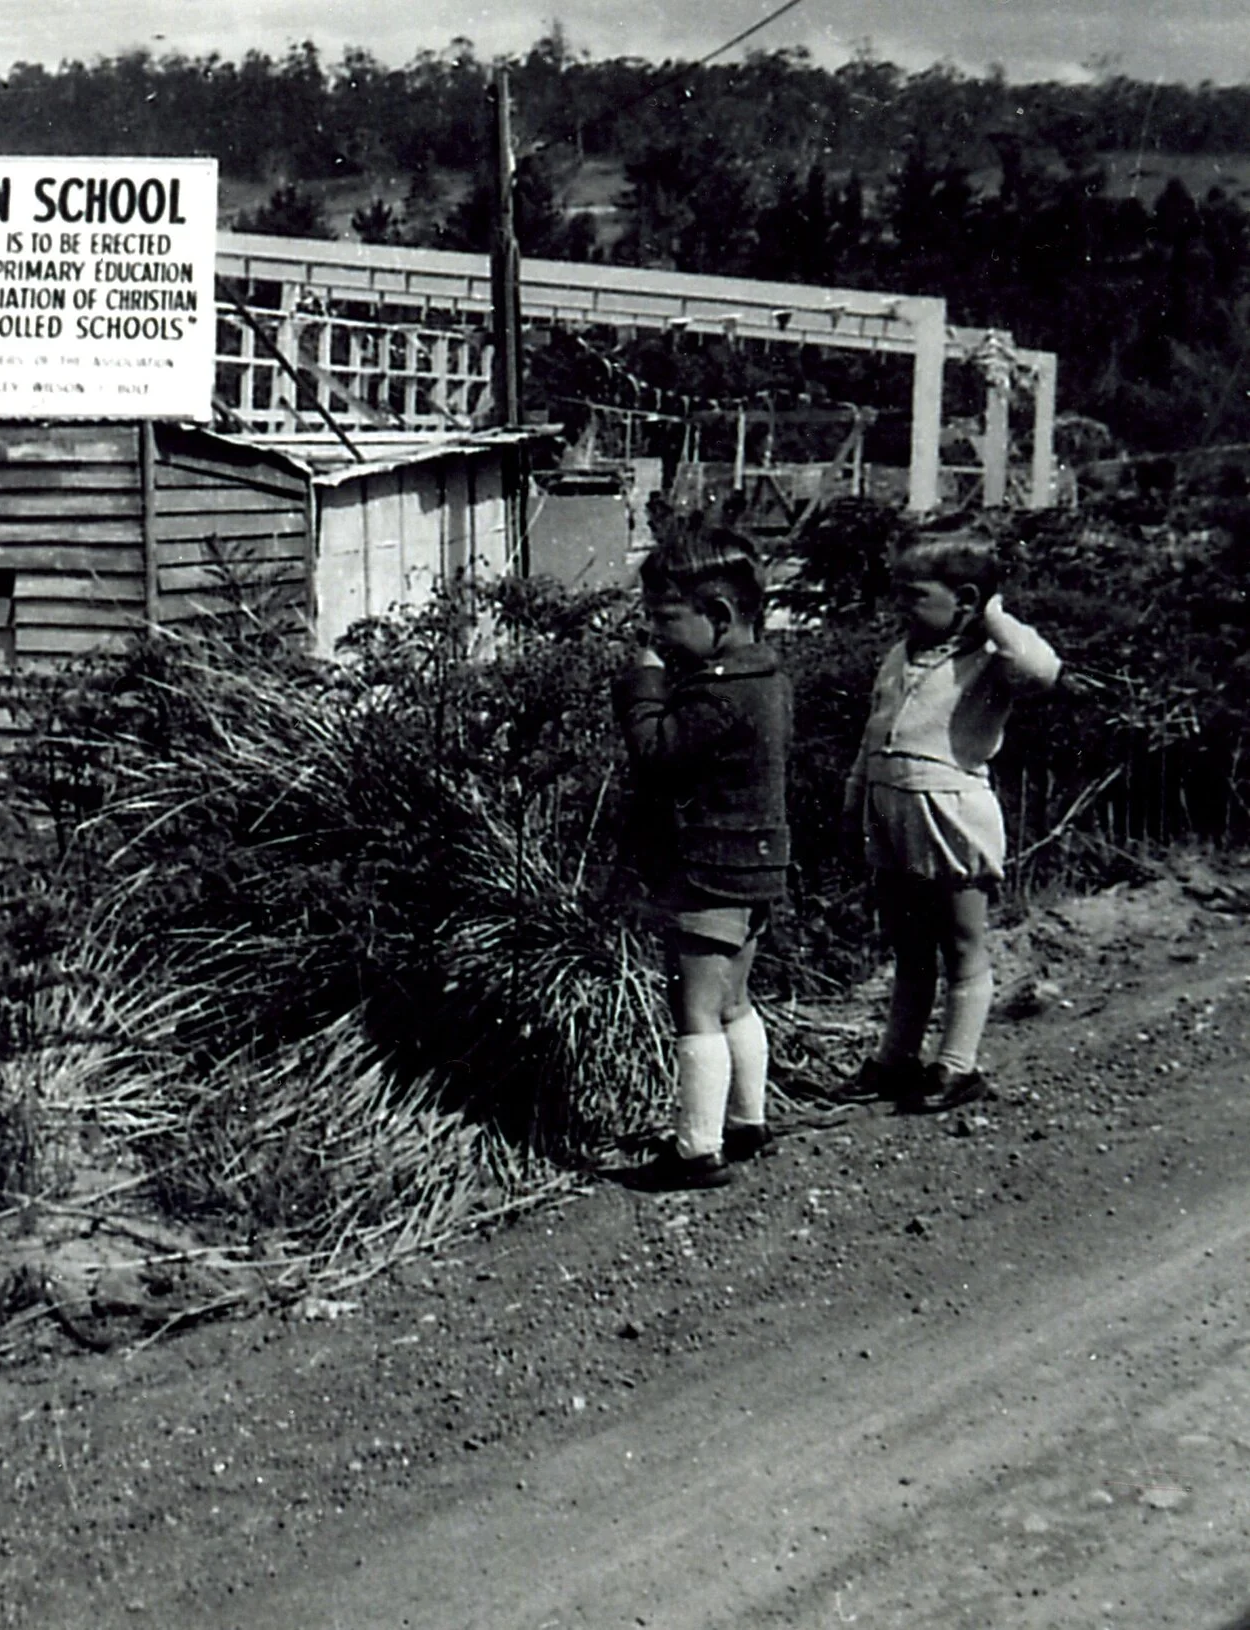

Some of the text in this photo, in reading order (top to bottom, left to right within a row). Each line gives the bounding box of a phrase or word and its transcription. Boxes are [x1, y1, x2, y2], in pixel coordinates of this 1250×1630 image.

[33, 178, 186, 224] SCHOOL
[7, 232, 23, 253] IS
[32, 233, 52, 253] TO
[60, 233, 79, 254] BE
[91, 234, 171, 255] ERECTED
[95, 262, 192, 283] EDUCATION
[73, 289, 96, 309] OF
[106, 289, 197, 311] CHRISTIAN
